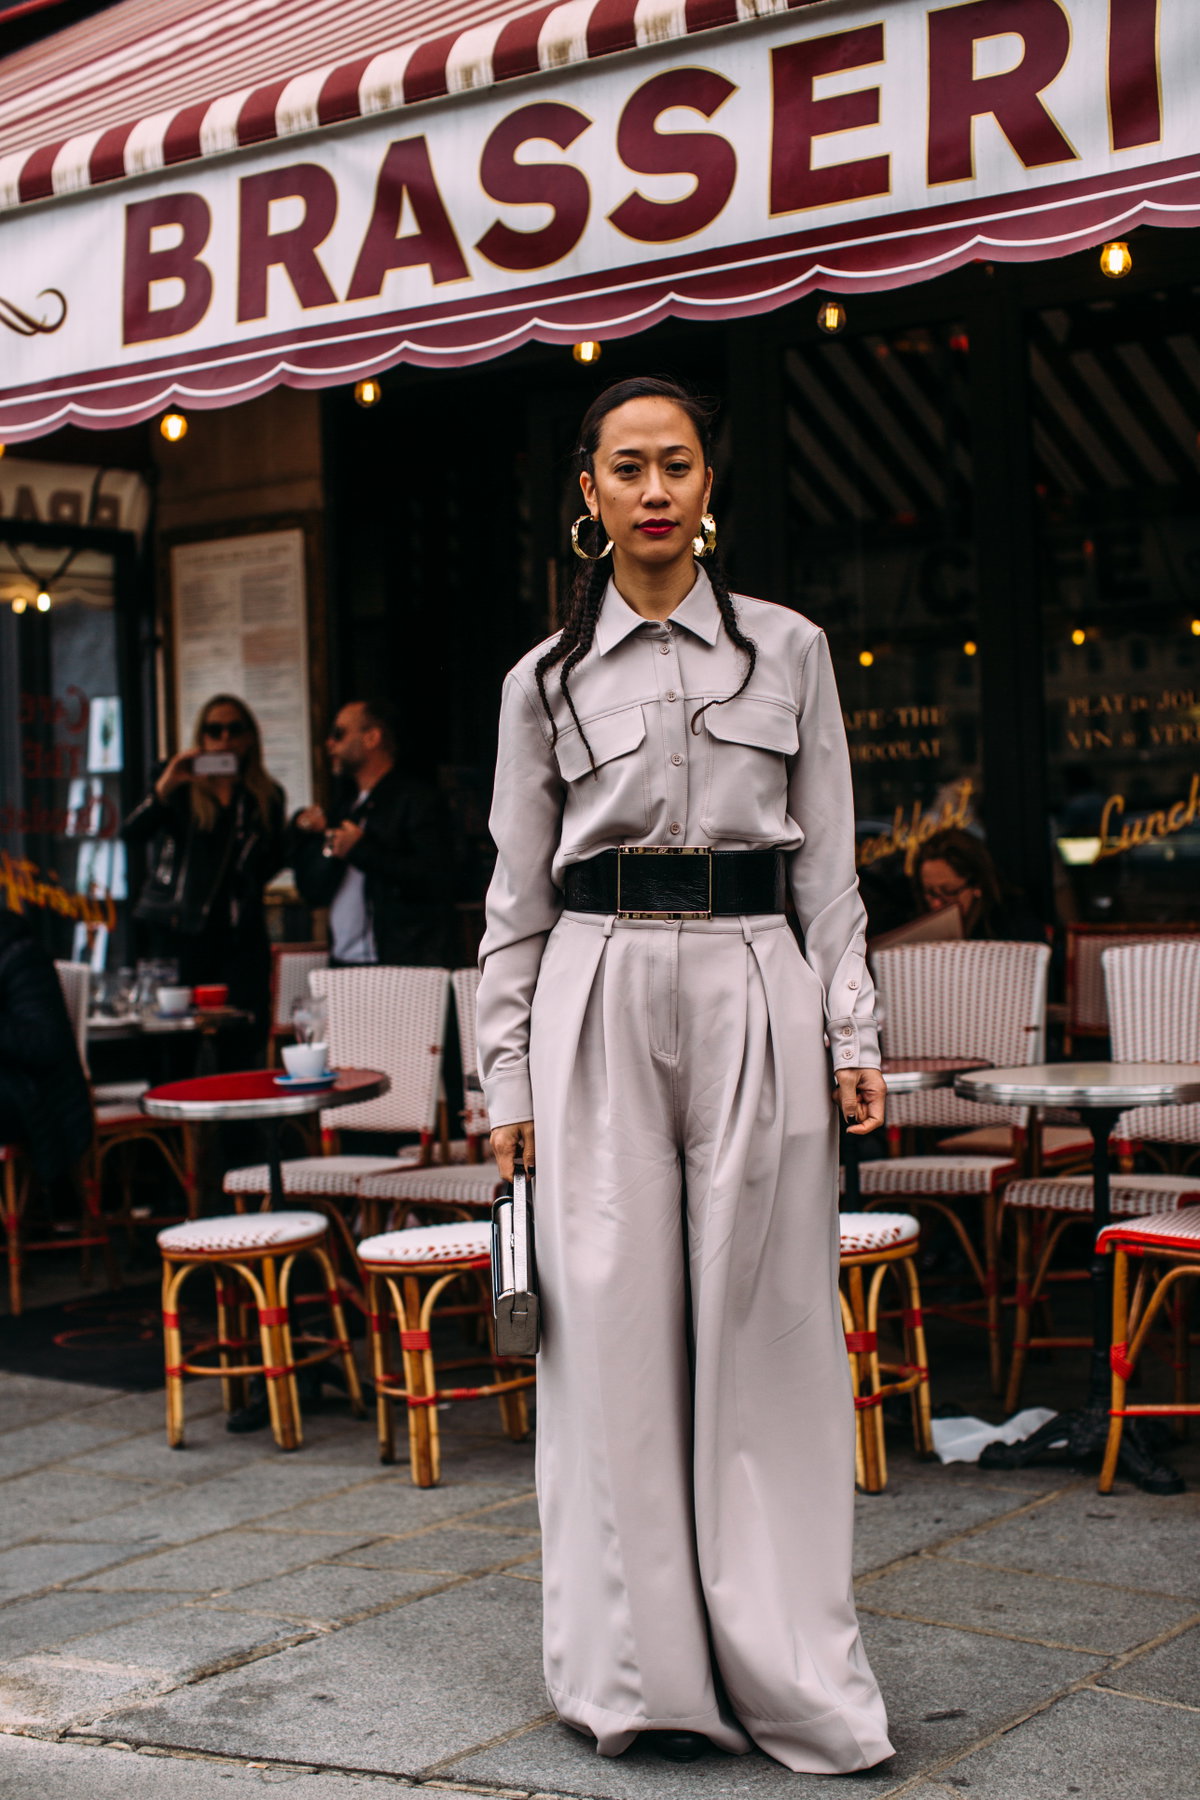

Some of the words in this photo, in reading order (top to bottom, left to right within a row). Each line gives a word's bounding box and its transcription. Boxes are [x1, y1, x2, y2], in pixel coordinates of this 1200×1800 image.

[121, 0, 1162, 349] BRASSERI
[849, 738, 941, 763] HOCOLAT
[1066, 728, 1114, 751] VIN
[855, 778, 974, 877] eakfast
